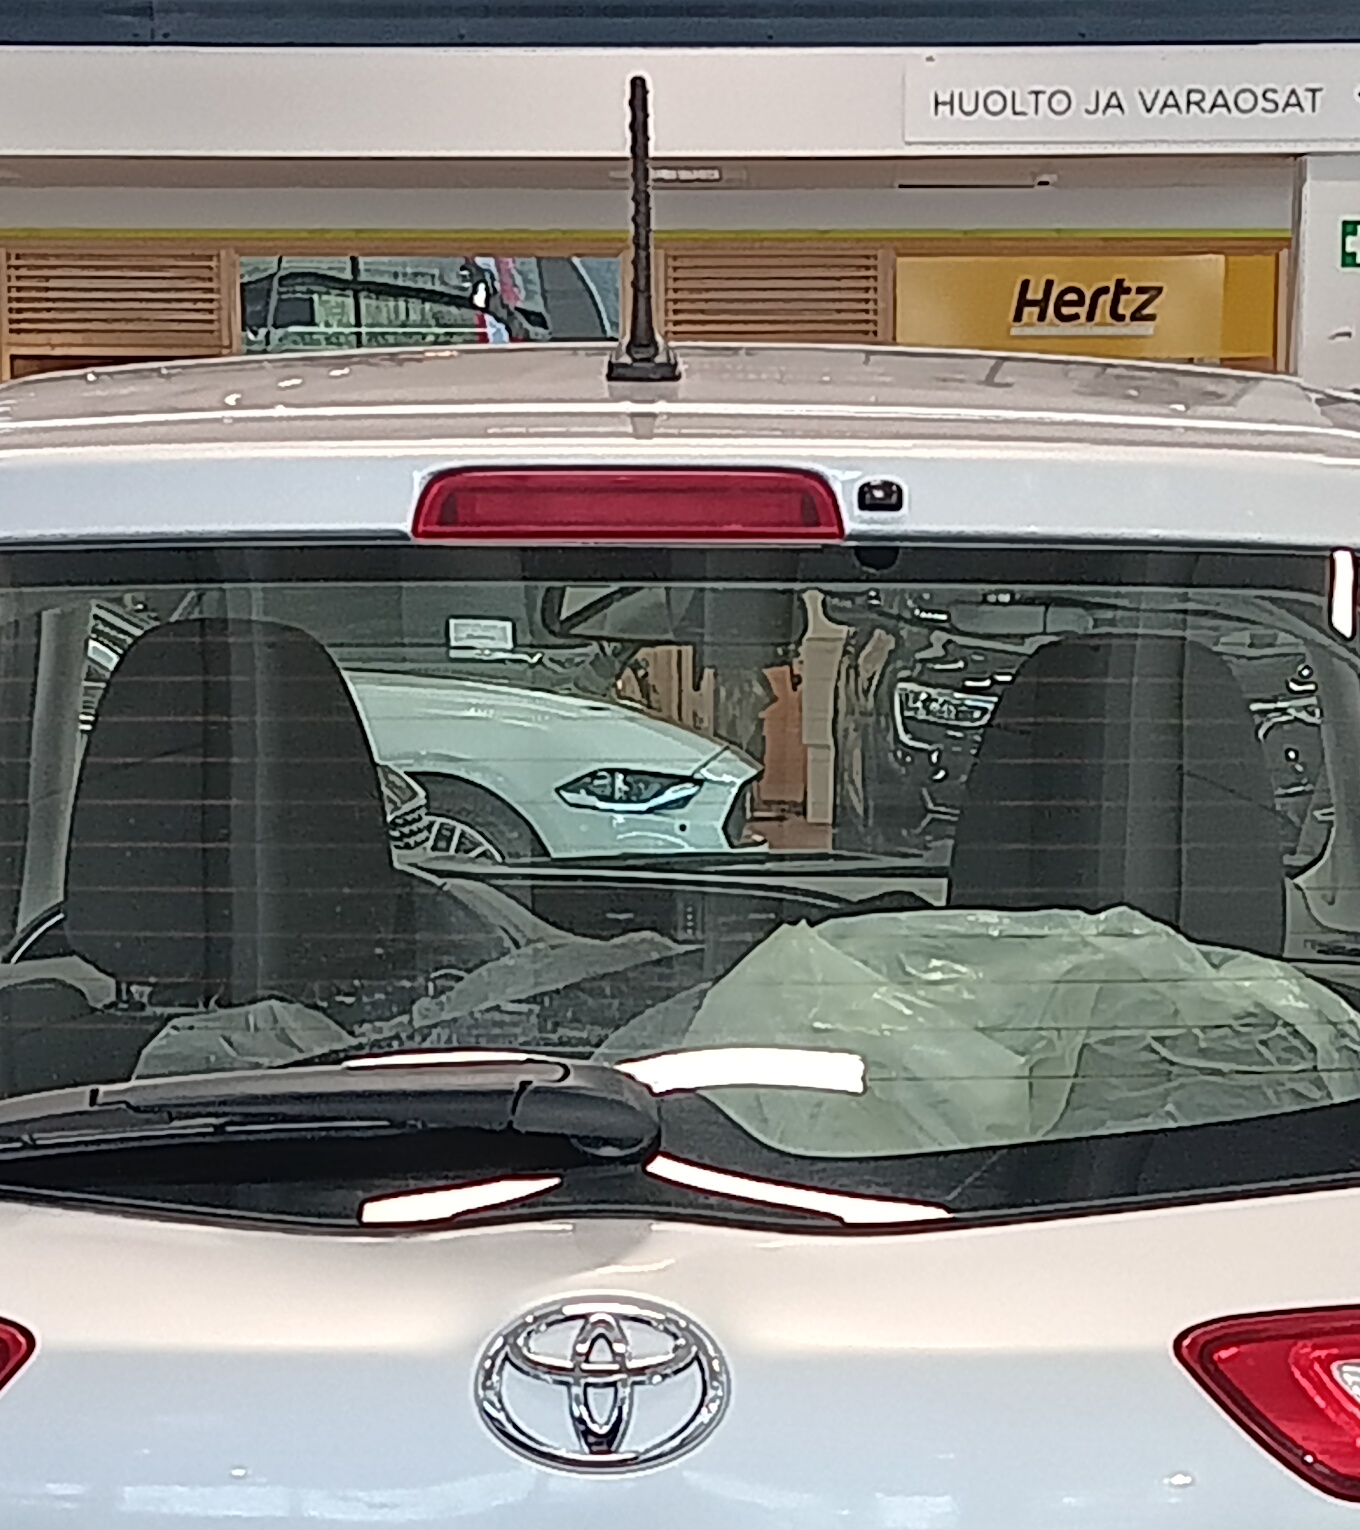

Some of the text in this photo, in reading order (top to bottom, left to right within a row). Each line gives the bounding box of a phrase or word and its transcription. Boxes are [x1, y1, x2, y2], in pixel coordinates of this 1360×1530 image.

[933, 86, 1324, 116] HUOLTO JA VARAOSAT
[1012, 278, 1165, 323] Hertz
